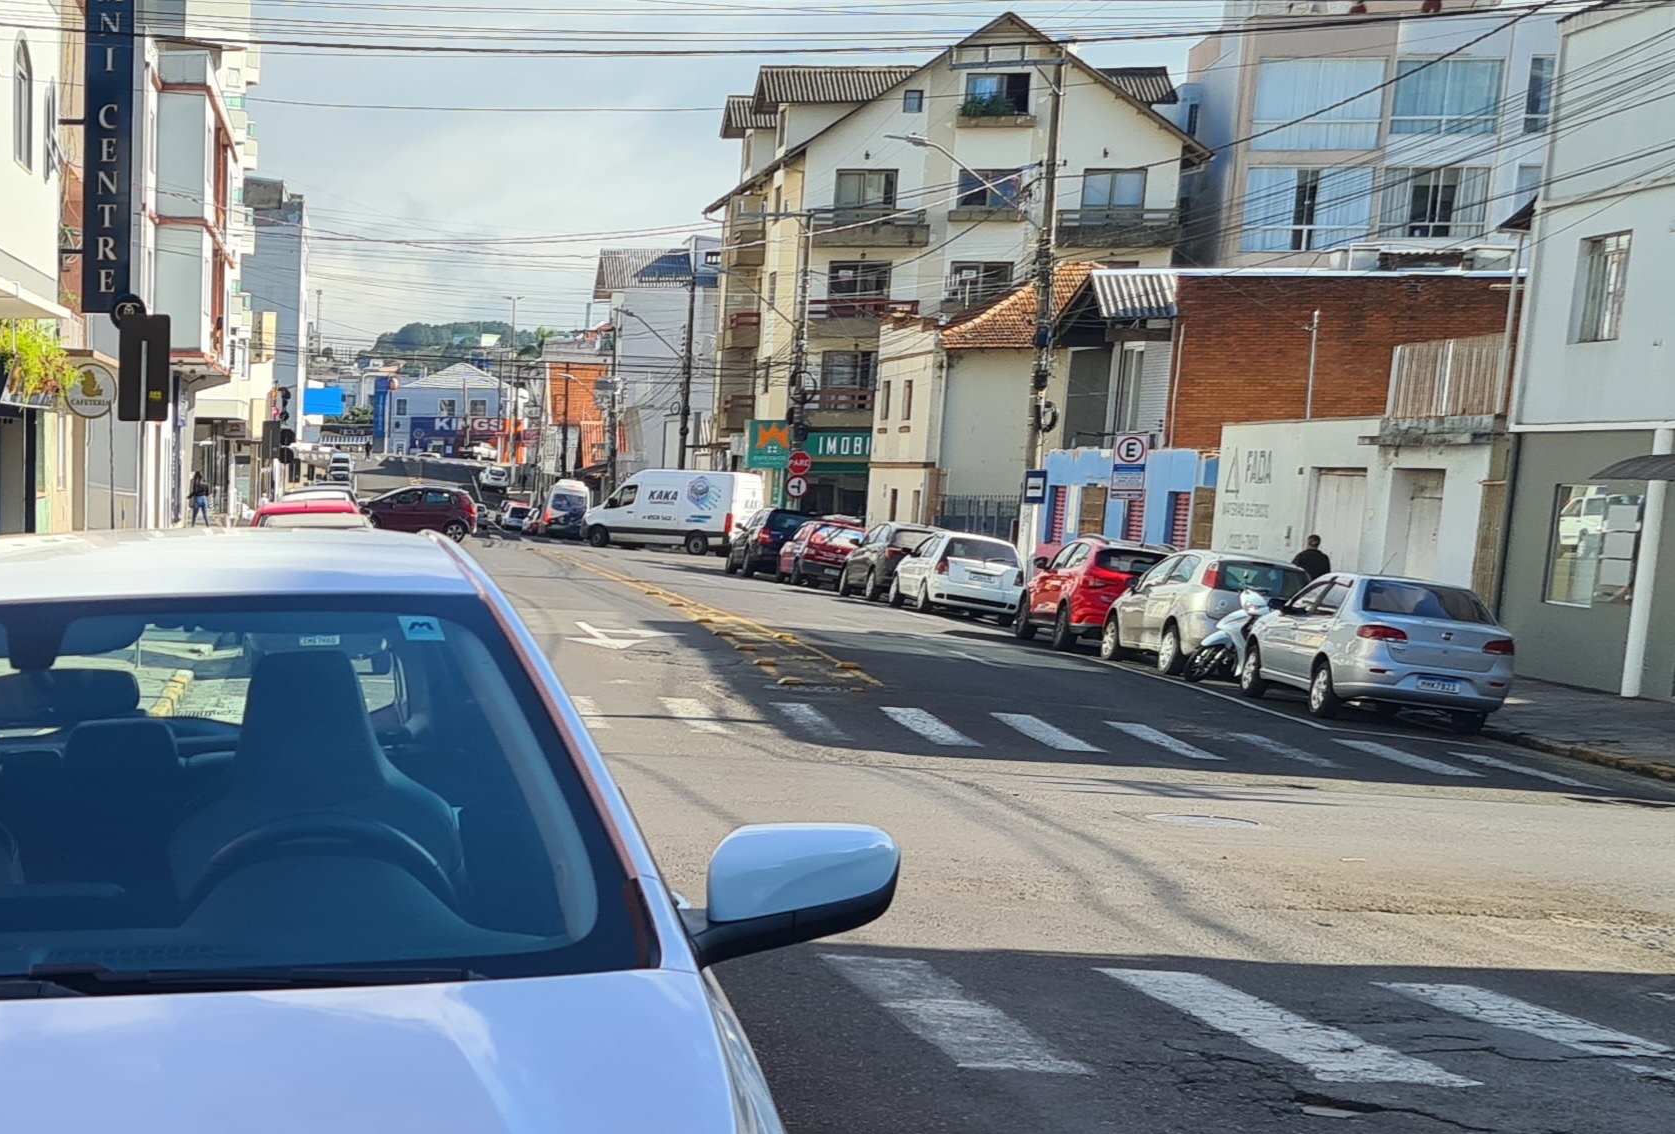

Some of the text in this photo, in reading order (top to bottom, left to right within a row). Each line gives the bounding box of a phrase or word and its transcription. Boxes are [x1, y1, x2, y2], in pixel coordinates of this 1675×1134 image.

[96, 0, 122, 293] NI CENTRE
[434, 417, 504, 432] KINGS
[1125, 442, 1137, 458] E
[647, 490, 679, 502] KAKA
